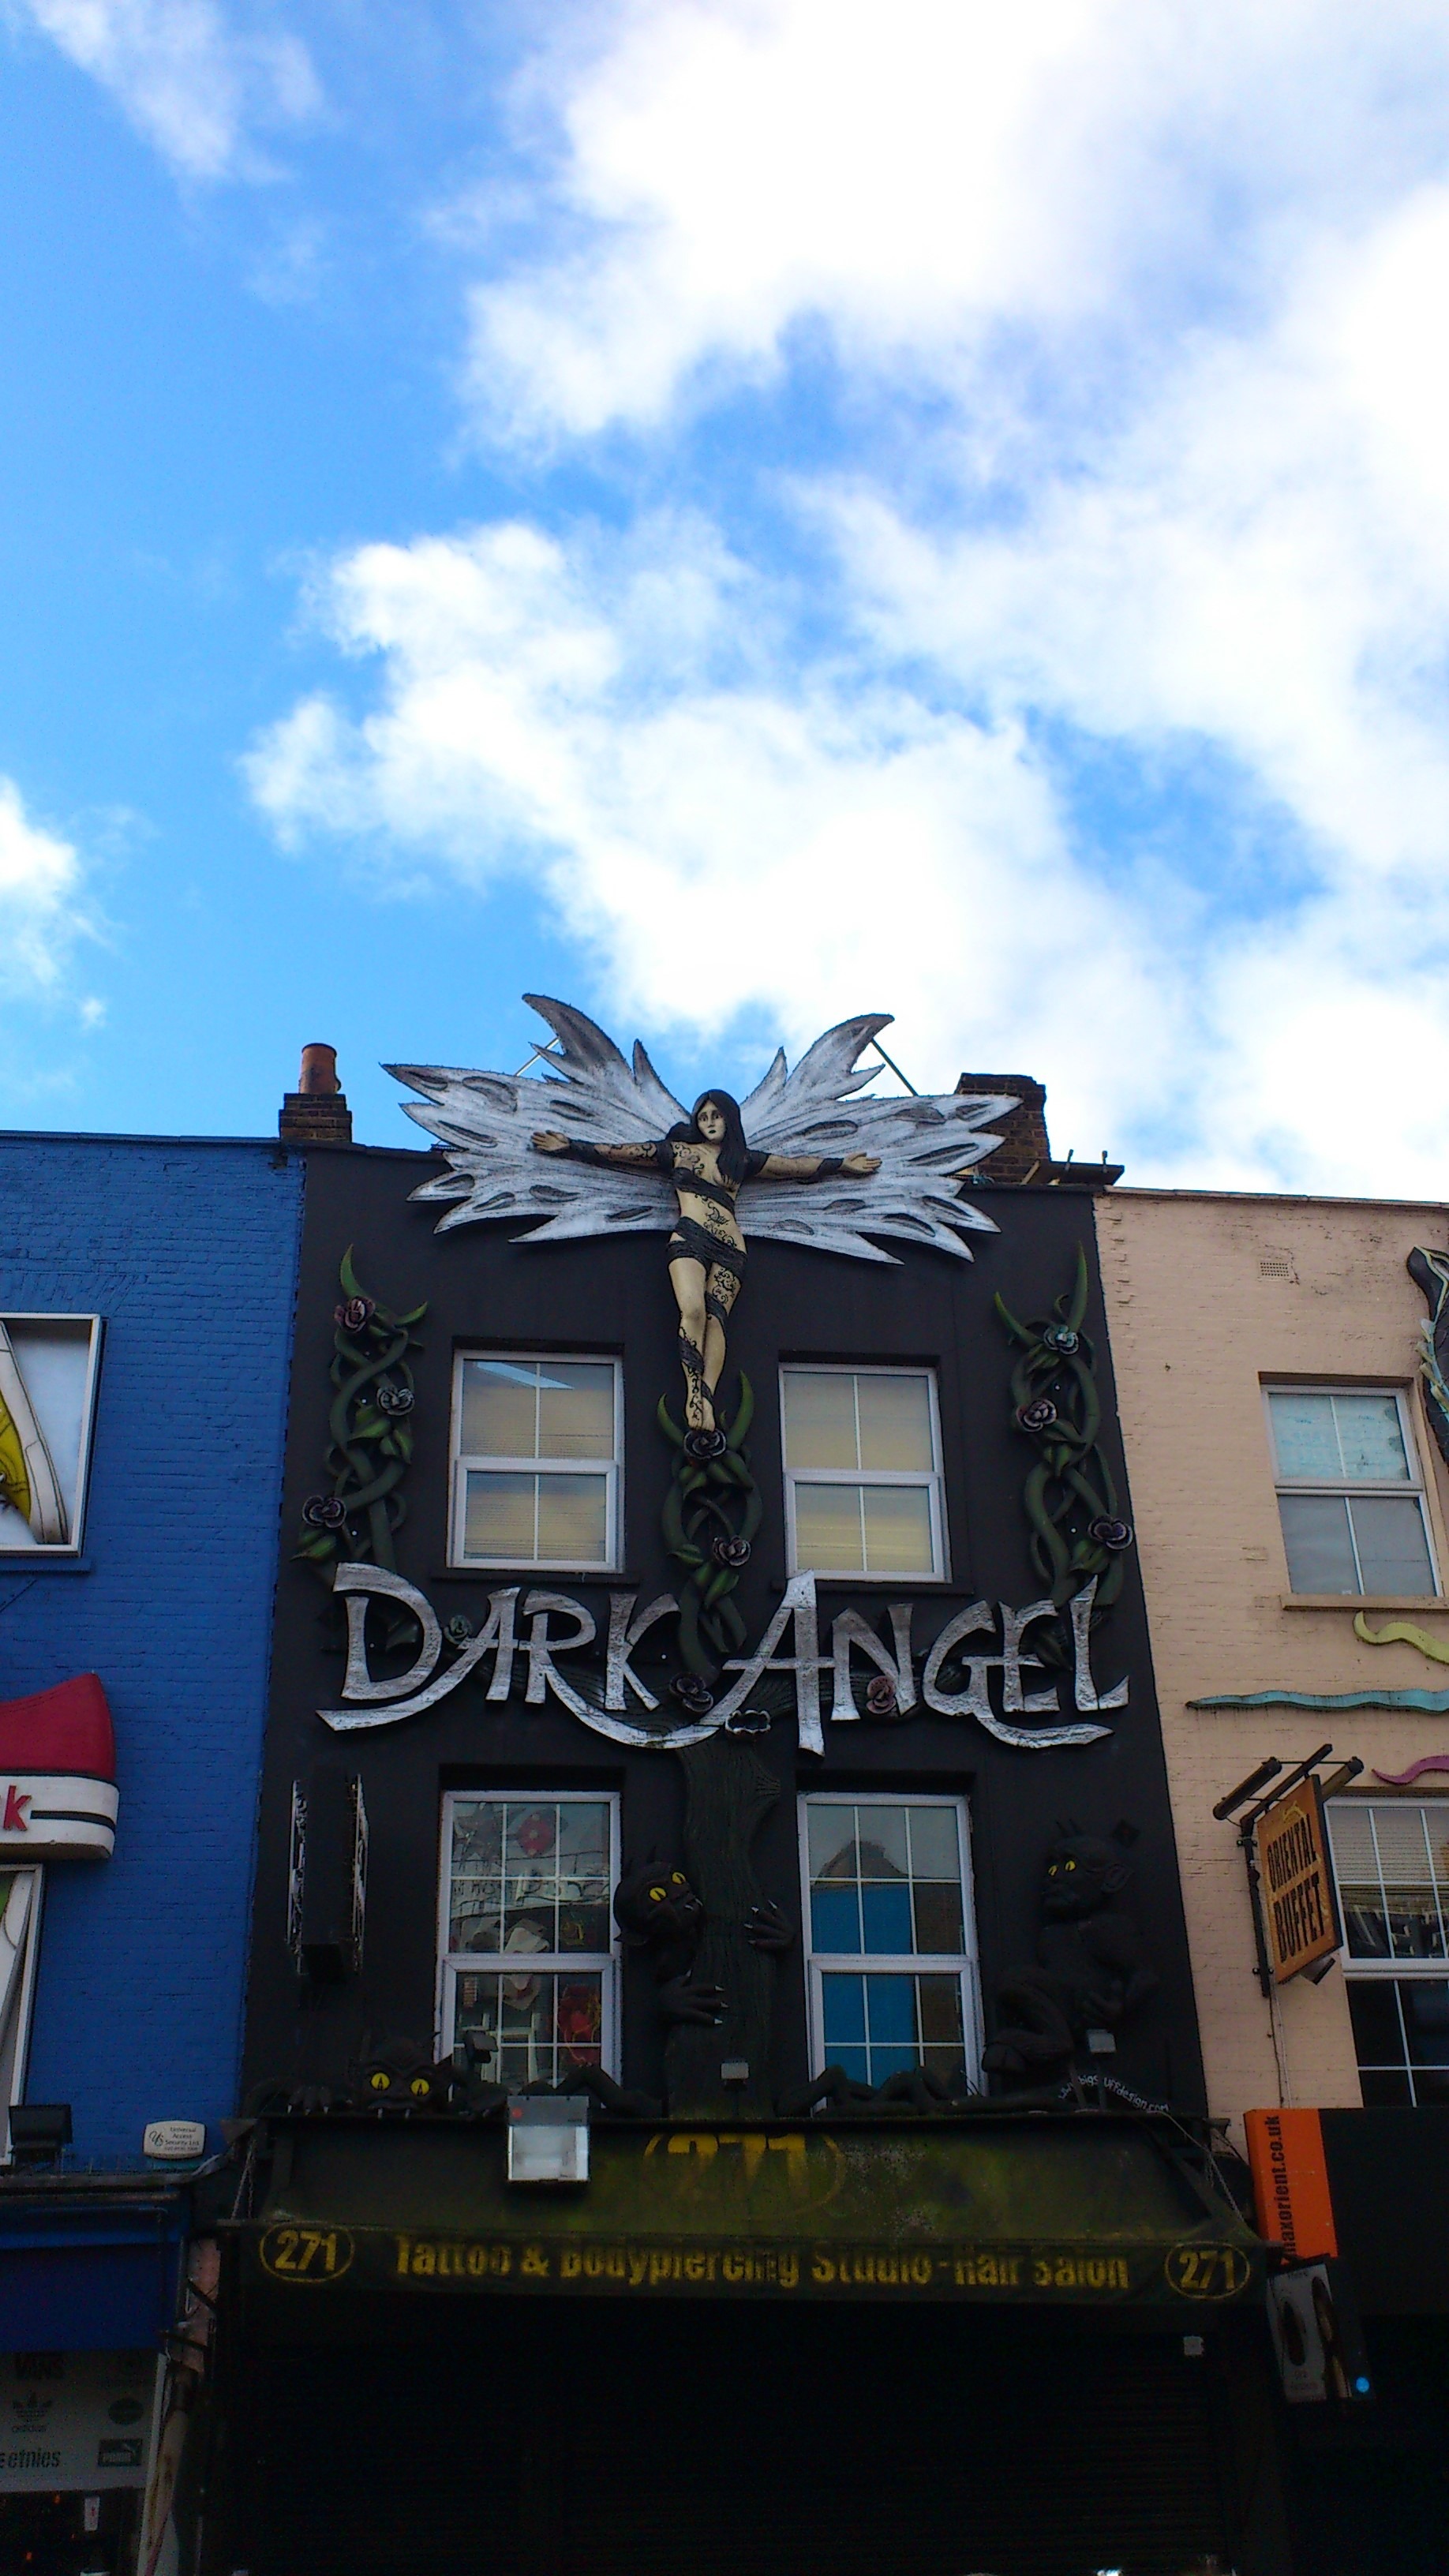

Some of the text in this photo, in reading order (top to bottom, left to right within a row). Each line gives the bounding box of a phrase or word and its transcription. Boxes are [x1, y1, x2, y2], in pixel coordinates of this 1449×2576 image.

[316, 1562, 1129, 1757] DARK ANGEL
[1267, 1813, 1317, 1893] ORIENTAL
[1273, 1870, 1325, 1964] BUFFET
[275, 2230, 339, 2272] 271
[520, 2246, 549, 2278] &
[1179, 2249, 1234, 2289] 271
[8, 2447, 61, 2469] etnies
